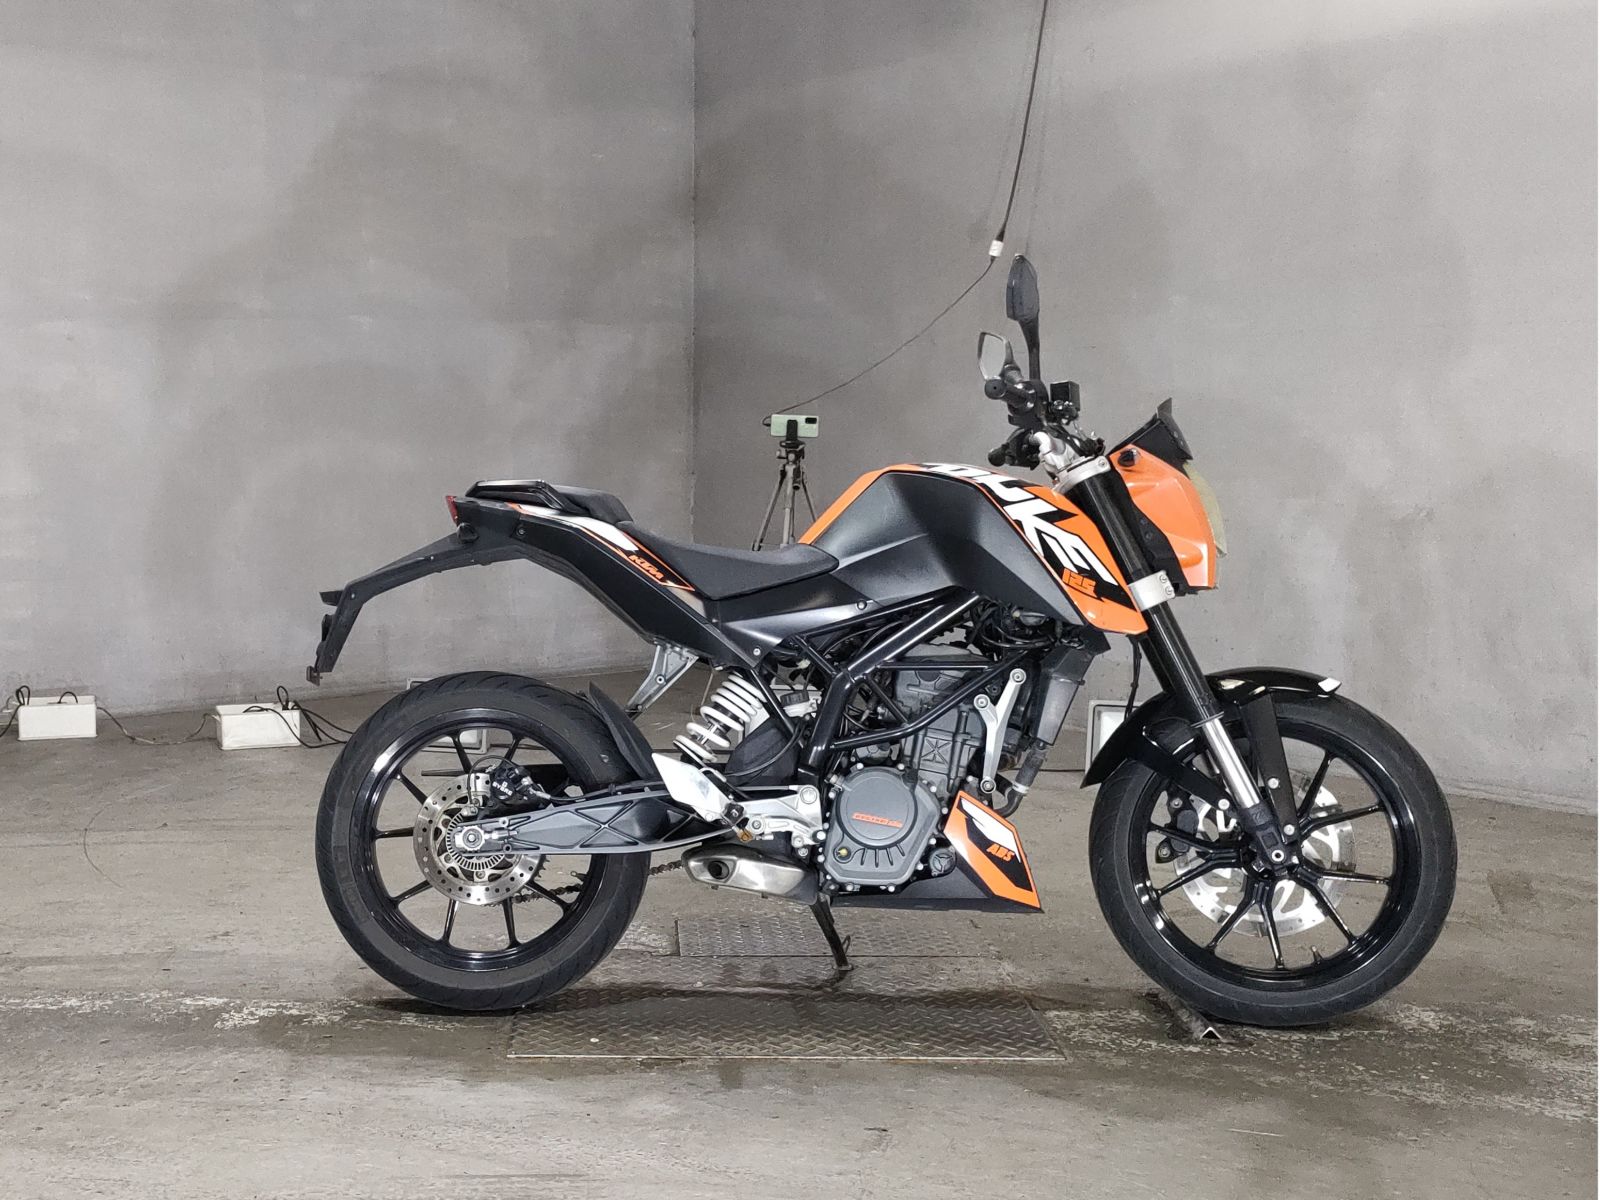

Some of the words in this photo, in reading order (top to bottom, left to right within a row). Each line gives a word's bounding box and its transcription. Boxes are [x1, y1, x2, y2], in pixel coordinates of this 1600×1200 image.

[922, 463, 1118, 586] DUKE
[628, 554, 665, 580] KTM
[1062, 567, 1097, 594] 125
[986, 843, 1015, 862] ABS
